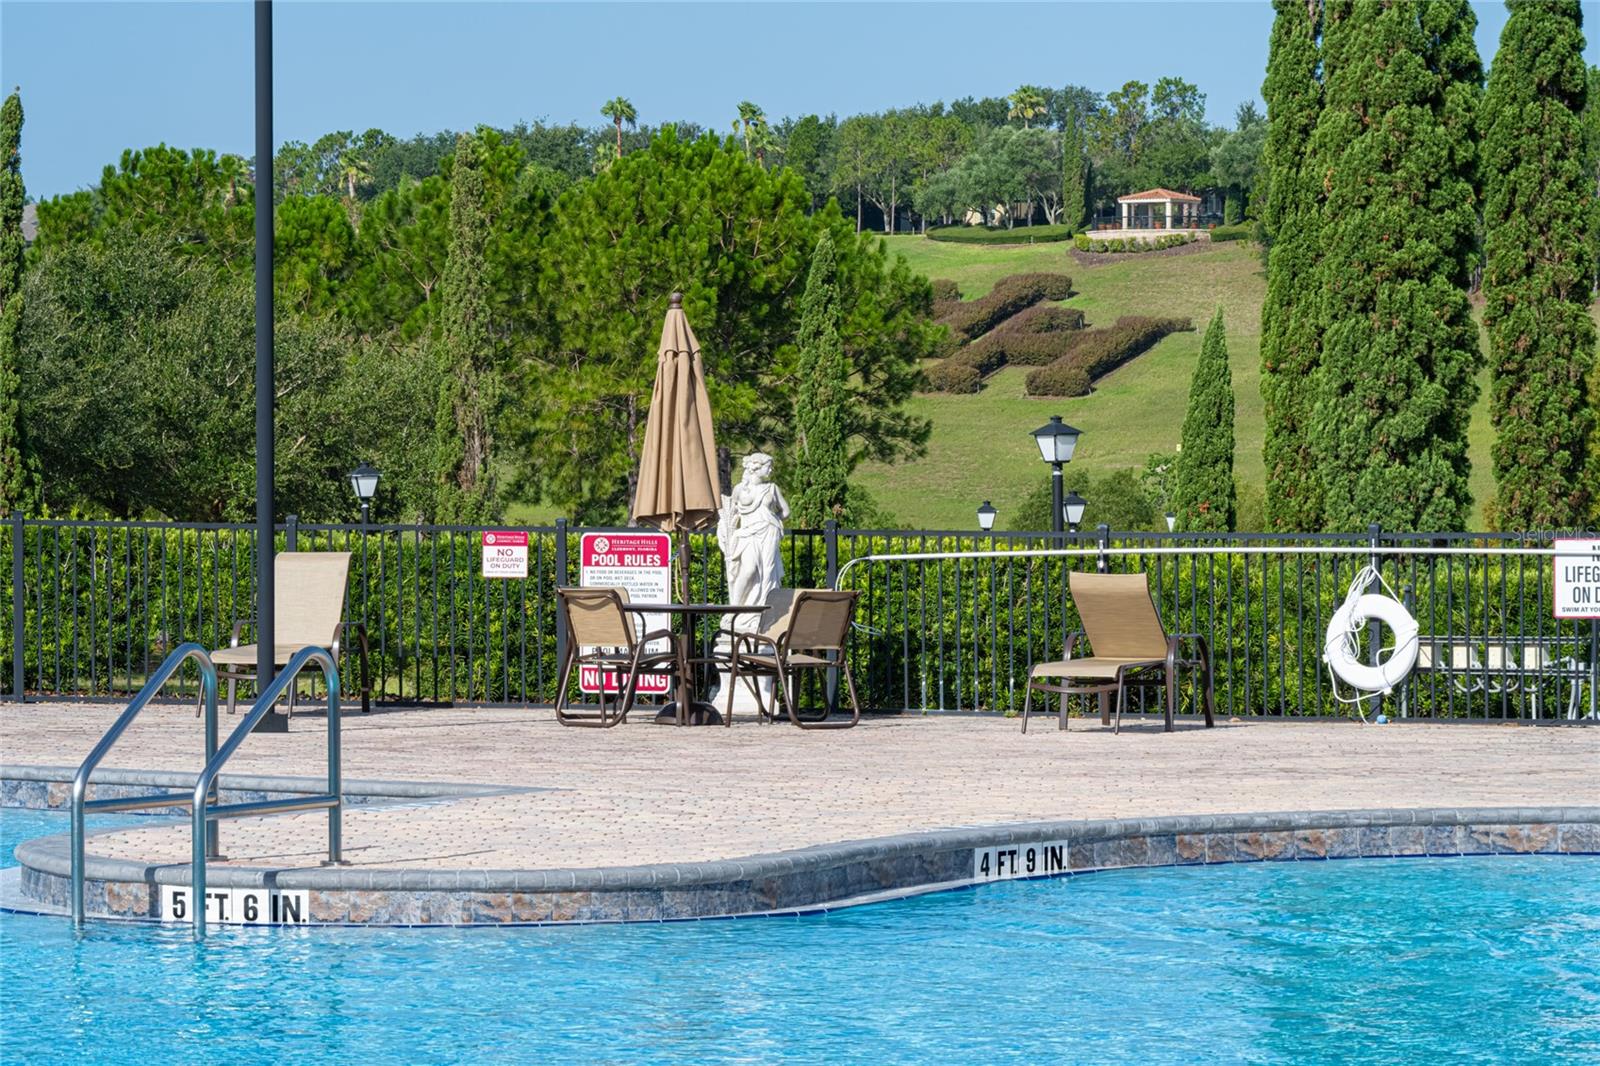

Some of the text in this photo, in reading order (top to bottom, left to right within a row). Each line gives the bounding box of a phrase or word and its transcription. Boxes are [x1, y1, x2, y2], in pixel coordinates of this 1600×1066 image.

[497, 548, 514, 557] NO
[591, 554, 661, 566] POOL RULES
[1572, 586, 1591, 604] ON
[612, 671, 666, 688] DIING
[980, 845, 1066, 876] 4 FT. 9 IN.
[172, 892, 186, 918] 5
[243, 894, 258, 922] 6
[272, 894, 306, 922] IN.
